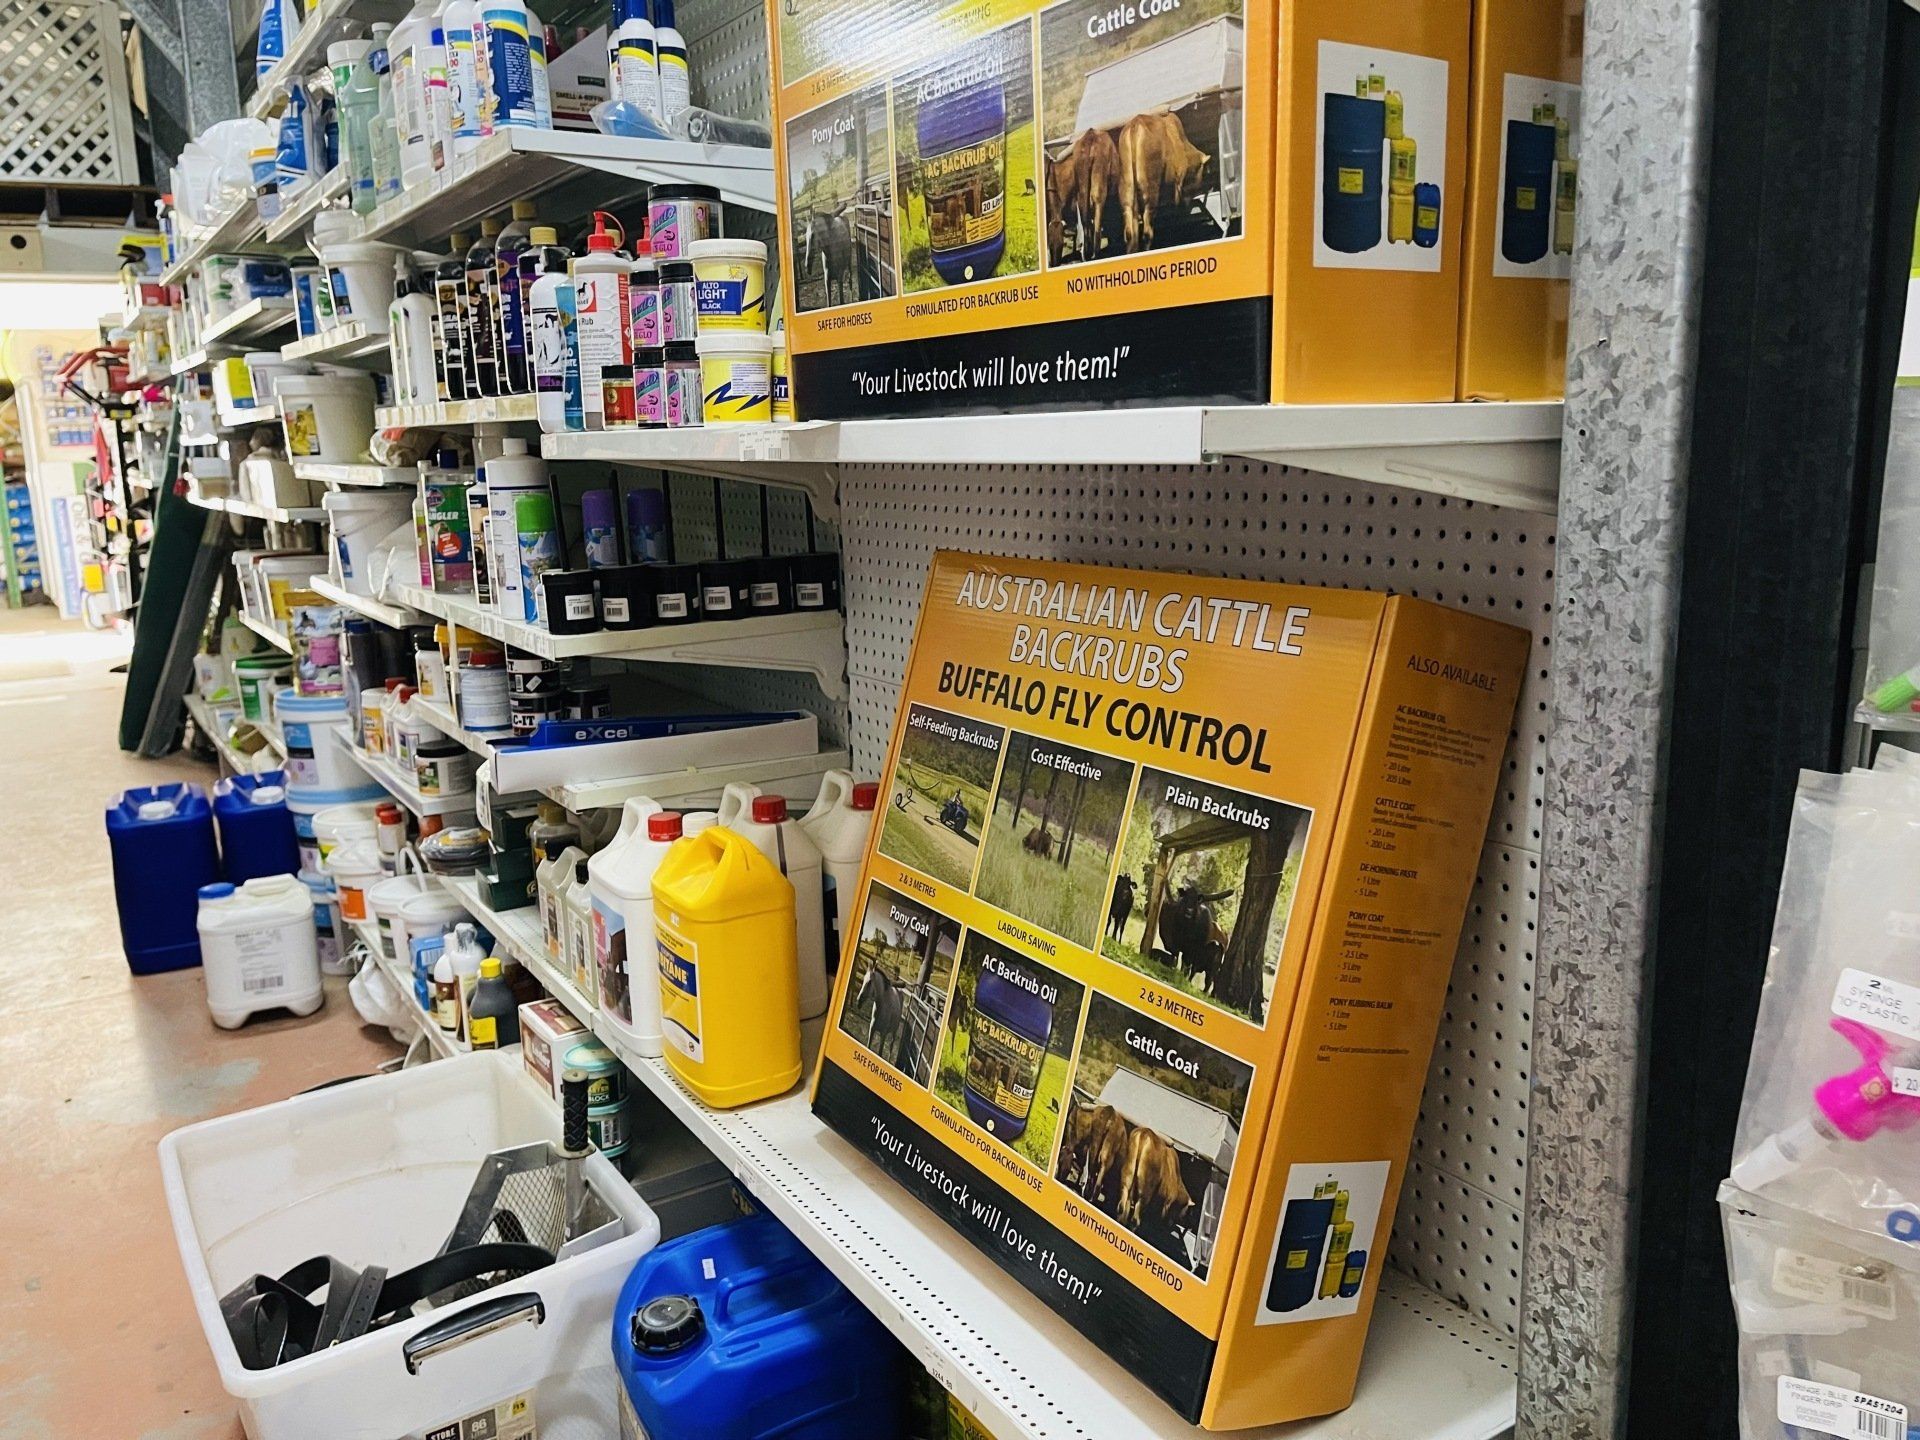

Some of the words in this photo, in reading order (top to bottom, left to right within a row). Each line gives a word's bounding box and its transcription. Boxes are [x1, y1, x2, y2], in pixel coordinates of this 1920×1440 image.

[1087, 3, 1135, 38] Cattle
[916, 82, 935, 104] AC
[934, 65, 982, 97] Backrub
[985, 53, 1003, 80] Oil
[812, 125, 832, 145] Pony
[834, 114, 855, 136] Coat
[928, 162, 940, 178] AC
[942, 147, 986, 176] BACKRUB
[988, 142, 1004, 161] OIL
[1066, 278, 1084, 295] NO
[1085, 265, 1168, 293] WITHHOLDING
[1170, 257, 1218, 281] PERIOD
[698, 289, 728, 300] LIGHT
[702, 302, 721, 310] BLACK
[906, 300, 958, 319] FORMULATED
[960, 295, 976, 311] FOR
[978, 288, 1019, 308] BACKRUB
[1021, 285, 1039, 302] USE
[818, 318, 832, 332] SAFE
[833, 316, 846, 330] FOR
[846, 312, 872, 328] HORSES
[852, 371, 890, 395] “Your
[894, 361, 968, 393] Livestock
[972, 358, 1004, 387] will
[1010, 356, 1049, 385] love
[1056, 346, 1130, 382] them!”
[956, 570, 1148, 632] AUSTRALIAN
[1152, 592, 1311, 656] CATTLE
[1008, 624, 1189, 694] BACKRUBS
[1407, 654, 1440, 676] ALSO
[1441, 664, 1498, 692] AVAILABLE
[938, 661, 1046, 716] BUFFALO
[1049, 685, 1104, 729] FLY
[1105, 698, 1272, 774] CONTROL
[1406, 706, 1436, 721] BACKRUB
[909, 712, 959, 742] Self-Feeding
[958, 727, 1000, 752] Backrubs
[1030, 747, 1053, 768] Cost
[1054, 753, 1102, 782] Effective
[1165, 786, 1200, 810] Plain
[1200, 795, 1271, 831] Backrubs
[1375, 796, 1399, 809] CATTLE
[898, 872, 904, 882] 2
[908, 877, 914, 887] 3
[913, 880, 936, 898] METRES
[1400, 870, 1418, 880] PASTE
[890, 905, 910, 928] Pony
[910, 916, 930, 937] Coat
[1348, 910, 1368, 922] PONY
[1368, 912, 1384, 922] COAT
[996, 920, 1024, 944] LABOUR
[1026, 930, 1056, 957] SAVING
[982, 954, 996, 974] AC
[997, 960, 1038, 994] Backrub
[1040, 984, 1058, 1005] Oil
[1868, 980, 1881, 990] 2
[1138, 988, 1146, 999] 2
[1147, 990, 1157, 1004] &
[1158, 994, 1164, 1008] 3
[1166, 998, 1205, 1027] METRES
[1330, 998, 1349, 1006] PONY
[1850, 986, 1902, 1010] SYRINGE
[1859, 1002, 1910, 1026] PLASTIC
[977, 1021, 988, 1034] AC
[988, 1025, 1028, 1056] BACKRUB
[1124, 1028, 1164, 1066] Cattle
[1166, 1047, 1200, 1080] Coat
[852, 1050, 868, 1068] SAFE
[868, 1059, 880, 1075] FOR
[879, 1065, 903, 1092] HORSES
[930, 1104, 976, 1146] FORMULATED
[976, 1136, 992, 1155] FOR
[991, 1145, 1027, 1182] BACKRUB
[1026, 1174, 1044, 1194] USE
[904, 1142, 968, 1209] Livestock
[971, 1193, 1002, 1233] will
[1001, 1216, 1037, 1262] love
[1064, 1200, 1078, 1218] NO
[1078, 1209, 1144, 1265] WITHHOLDING
[1145, 1256, 1184, 1293] PERIOD
[1785, 1381, 1820, 1396] SYRINGE
